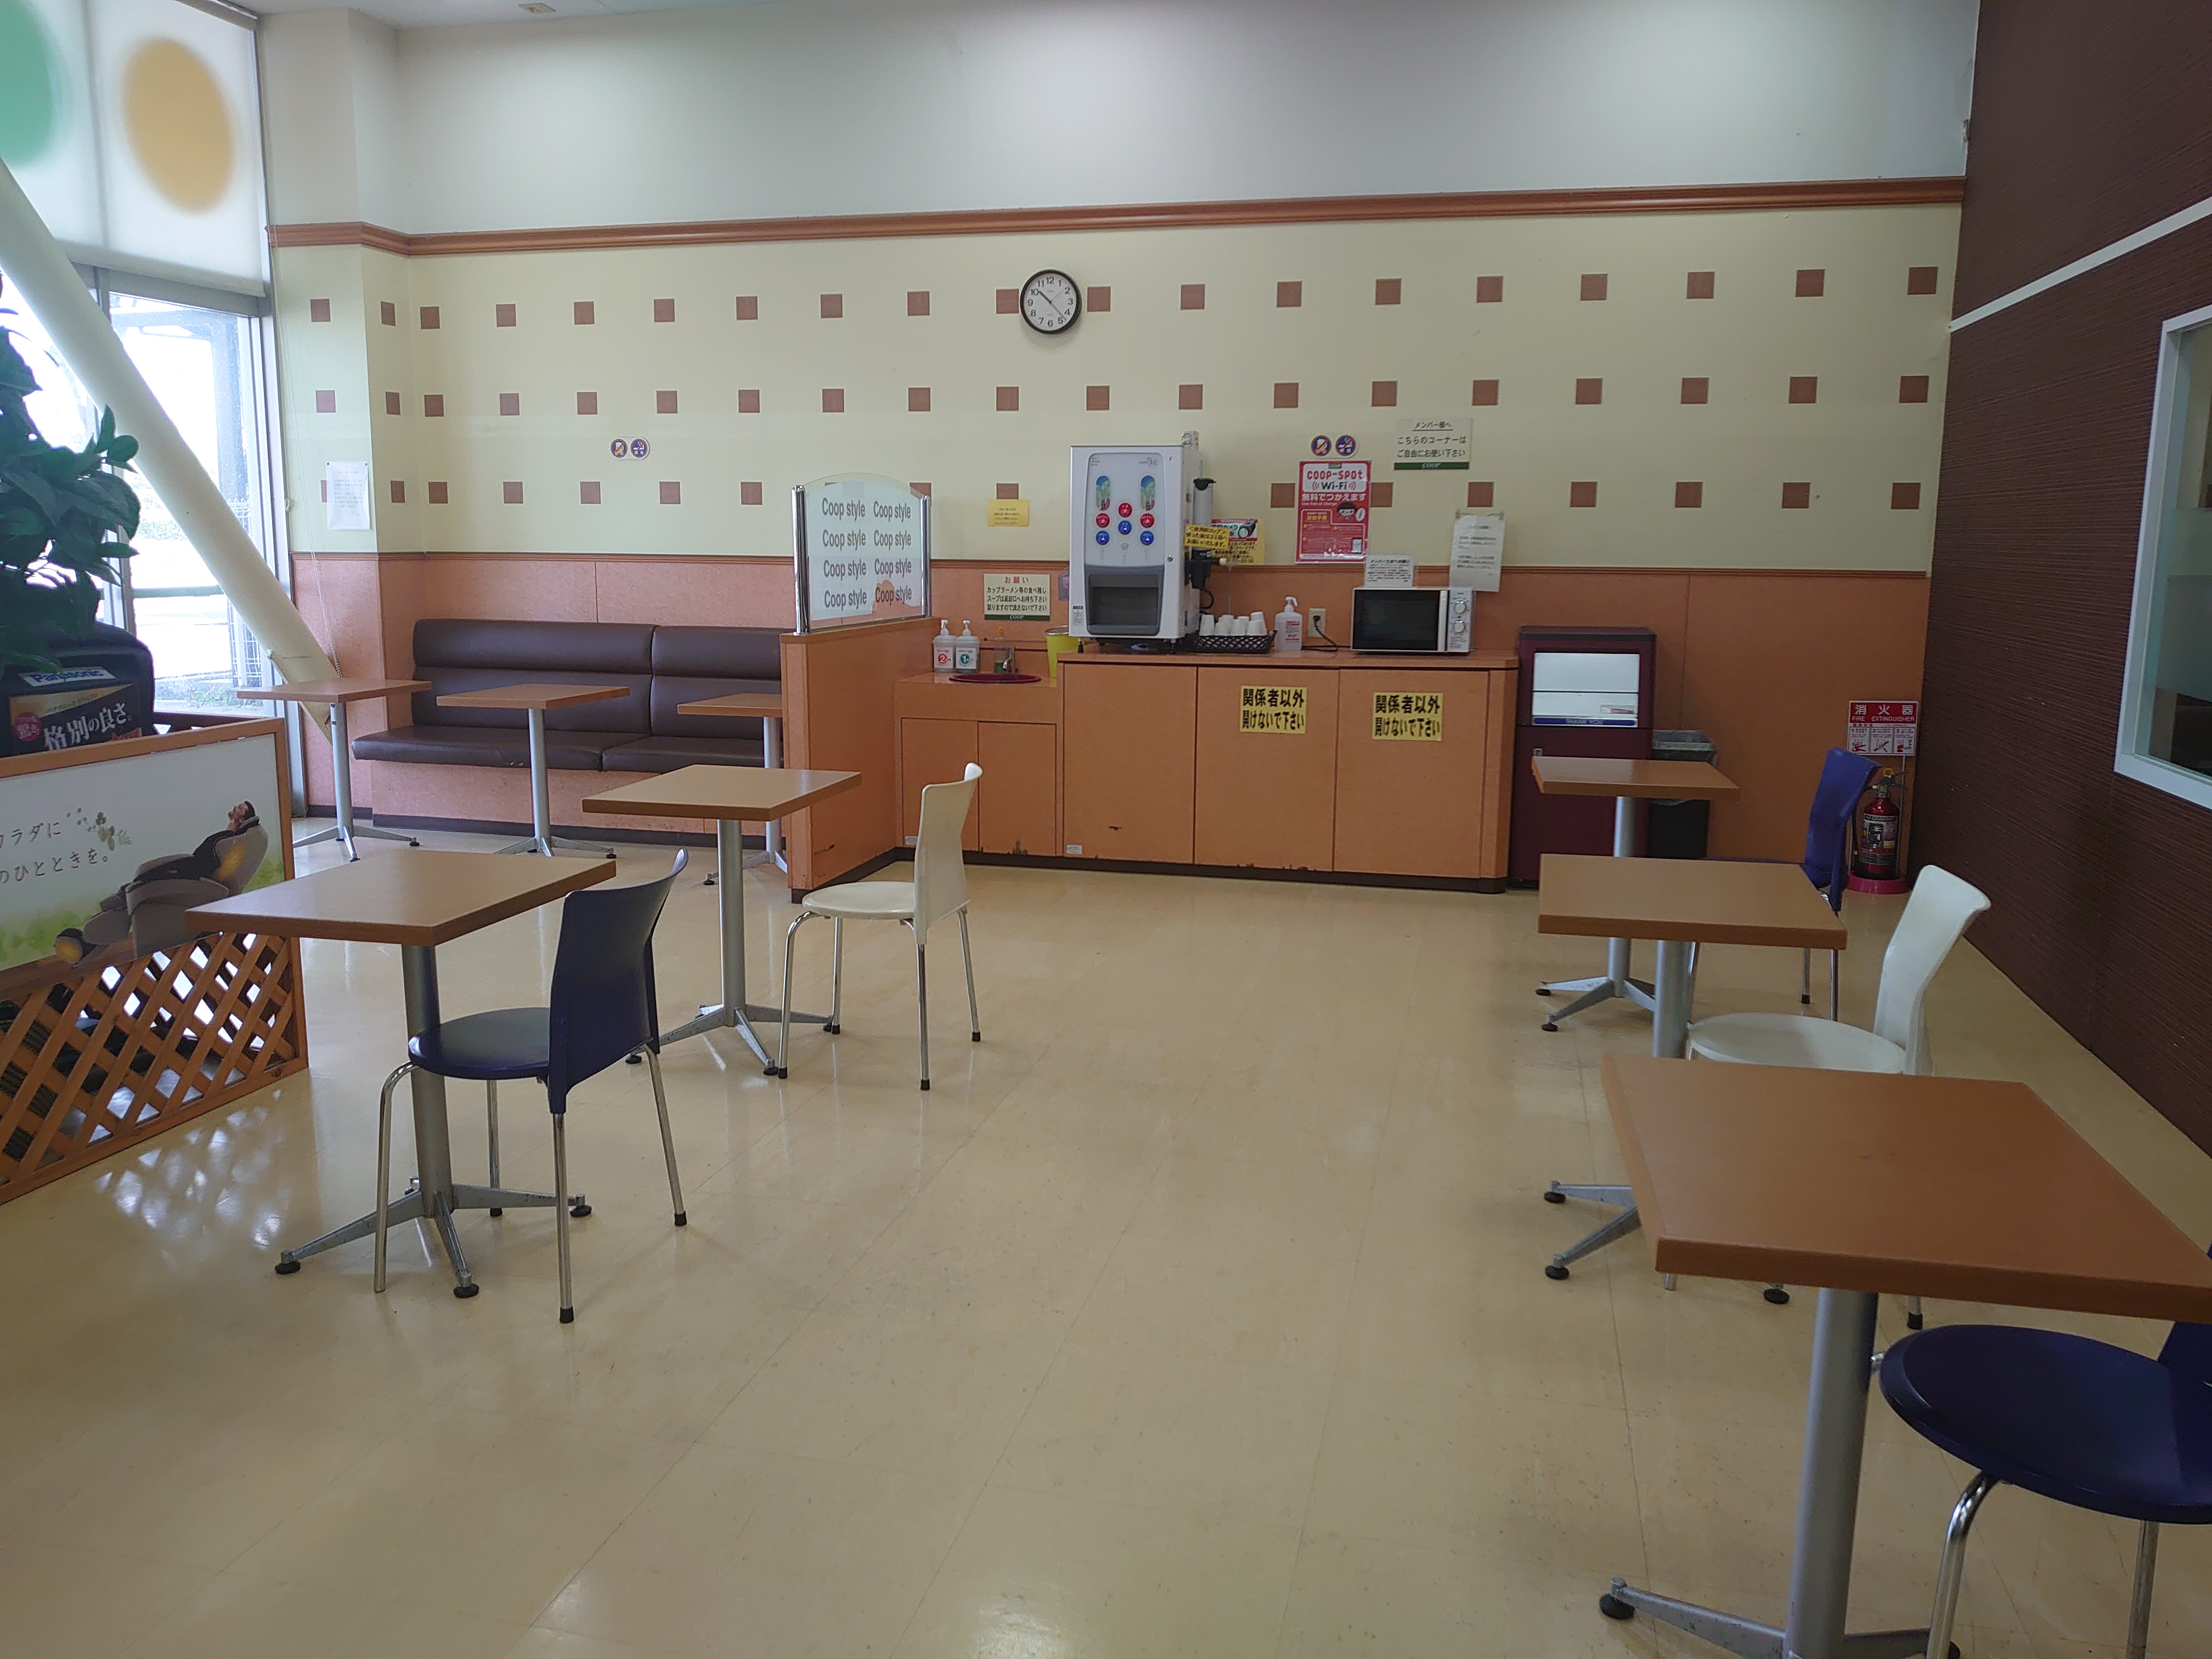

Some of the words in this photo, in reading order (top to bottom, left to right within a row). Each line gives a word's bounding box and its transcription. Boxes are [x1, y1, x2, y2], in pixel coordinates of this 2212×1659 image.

[1397, 435, 1466, 444] こちらのコーナーは
[1397, 448, 1465, 458] ご自由にお使い下さい
[1321, 481, 1347, 490] Wi-Fi
[1302, 493, 1366, 501] 無料でつかえます
[822, 497, 844, 521] Coop
[847, 500, 866, 521] style
[873, 500, 893, 522] Coop
[894, 503, 911, 522] style
[823, 529, 845, 551] Coop
[847, 529, 866, 550] style
[874, 529, 893, 550] Coop
[895, 530, 911, 550] style
[824, 560, 845, 581] Coop
[848, 558, 867, 580] style
[874, 558, 893, 578] Coop
[895, 557, 912, 578] style
[1005, 576, 1029, 584] お願い
[825, 590, 847, 611] Coop
[848, 588, 867, 610] style
[875, 586, 894, 606] Coop
[895, 585, 912, 604] style
[940, 654, 945, 663] 2
[1243, 689, 1305, 708] 関係者以外
[1375, 695, 1440, 714] 関係者以外
[1855, 704, 1914, 715] 消火器
[1242, 710, 1304, 730] 開けないで下さい
[1374, 717, 1440, 737] 開けないで下さい
